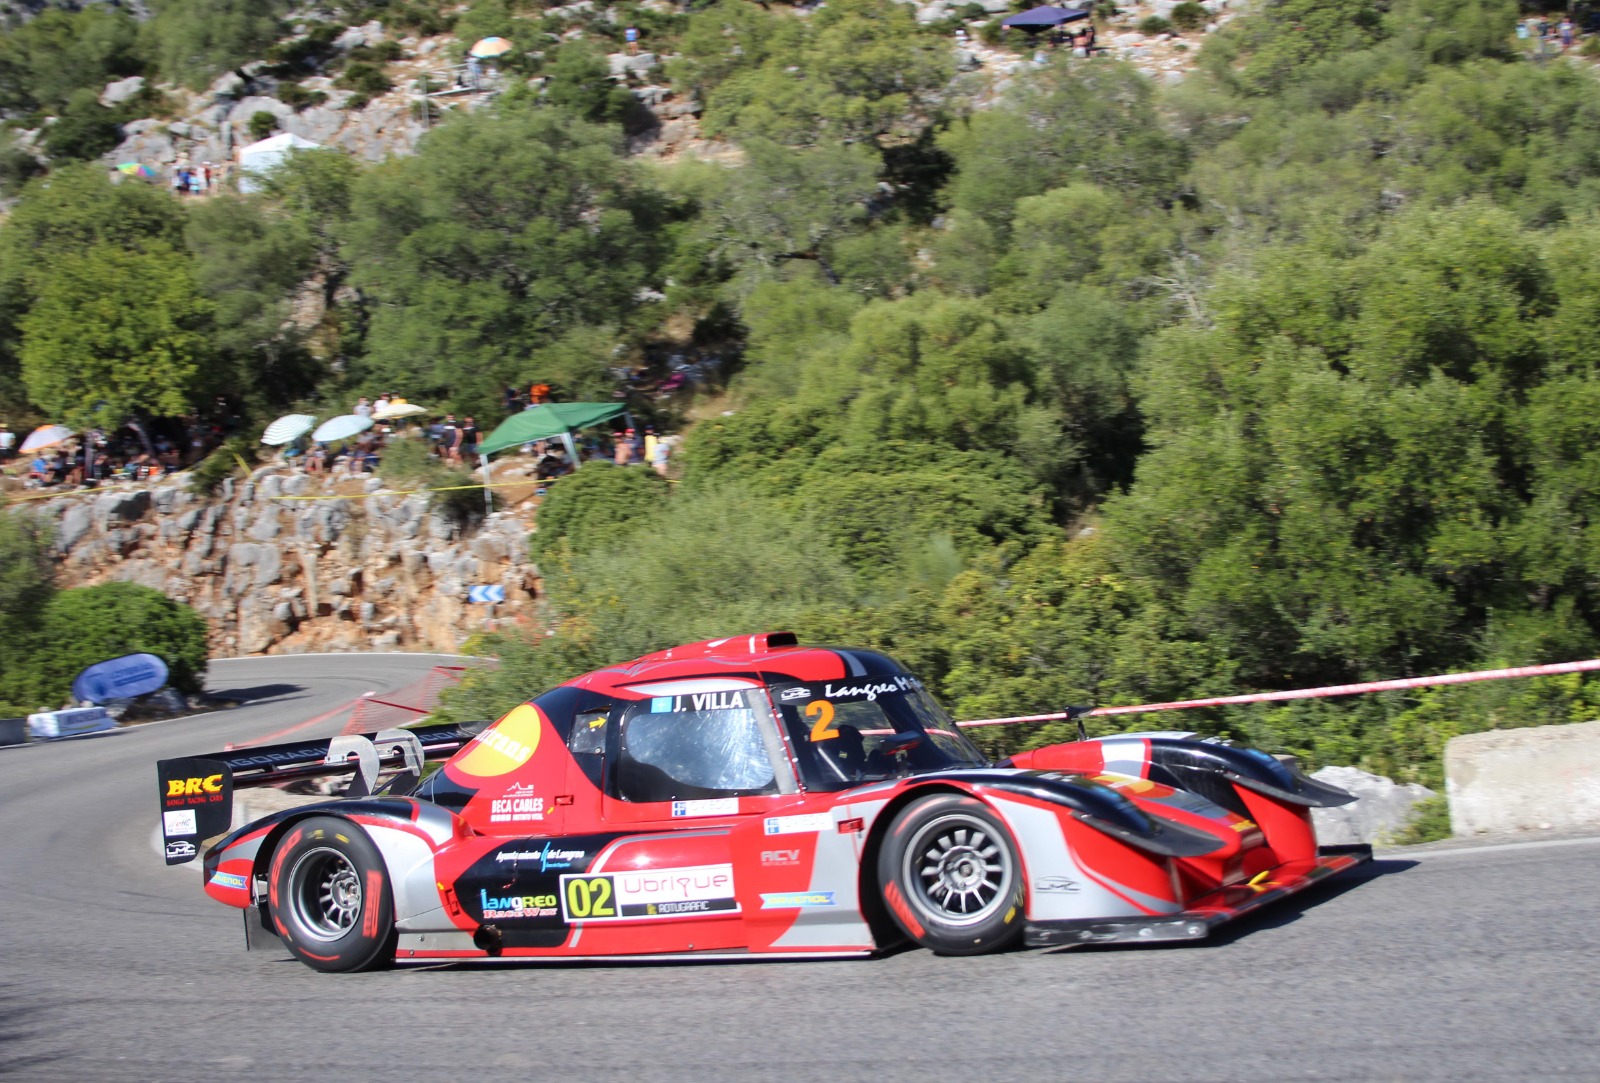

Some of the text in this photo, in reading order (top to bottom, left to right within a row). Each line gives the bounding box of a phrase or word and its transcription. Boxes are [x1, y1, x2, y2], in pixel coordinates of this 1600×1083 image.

[673, 691, 744, 713] J. VILLA
[805, 700, 840, 742] 2
[166, 773, 224, 797] BRC
[210, 794, 224, 804] CARS
[491, 797, 544, 814] BECA CABLES
[760, 848, 801, 861] ACV
[567, 878, 615, 917] 02
[623, 874, 729, 898] Ubrique
